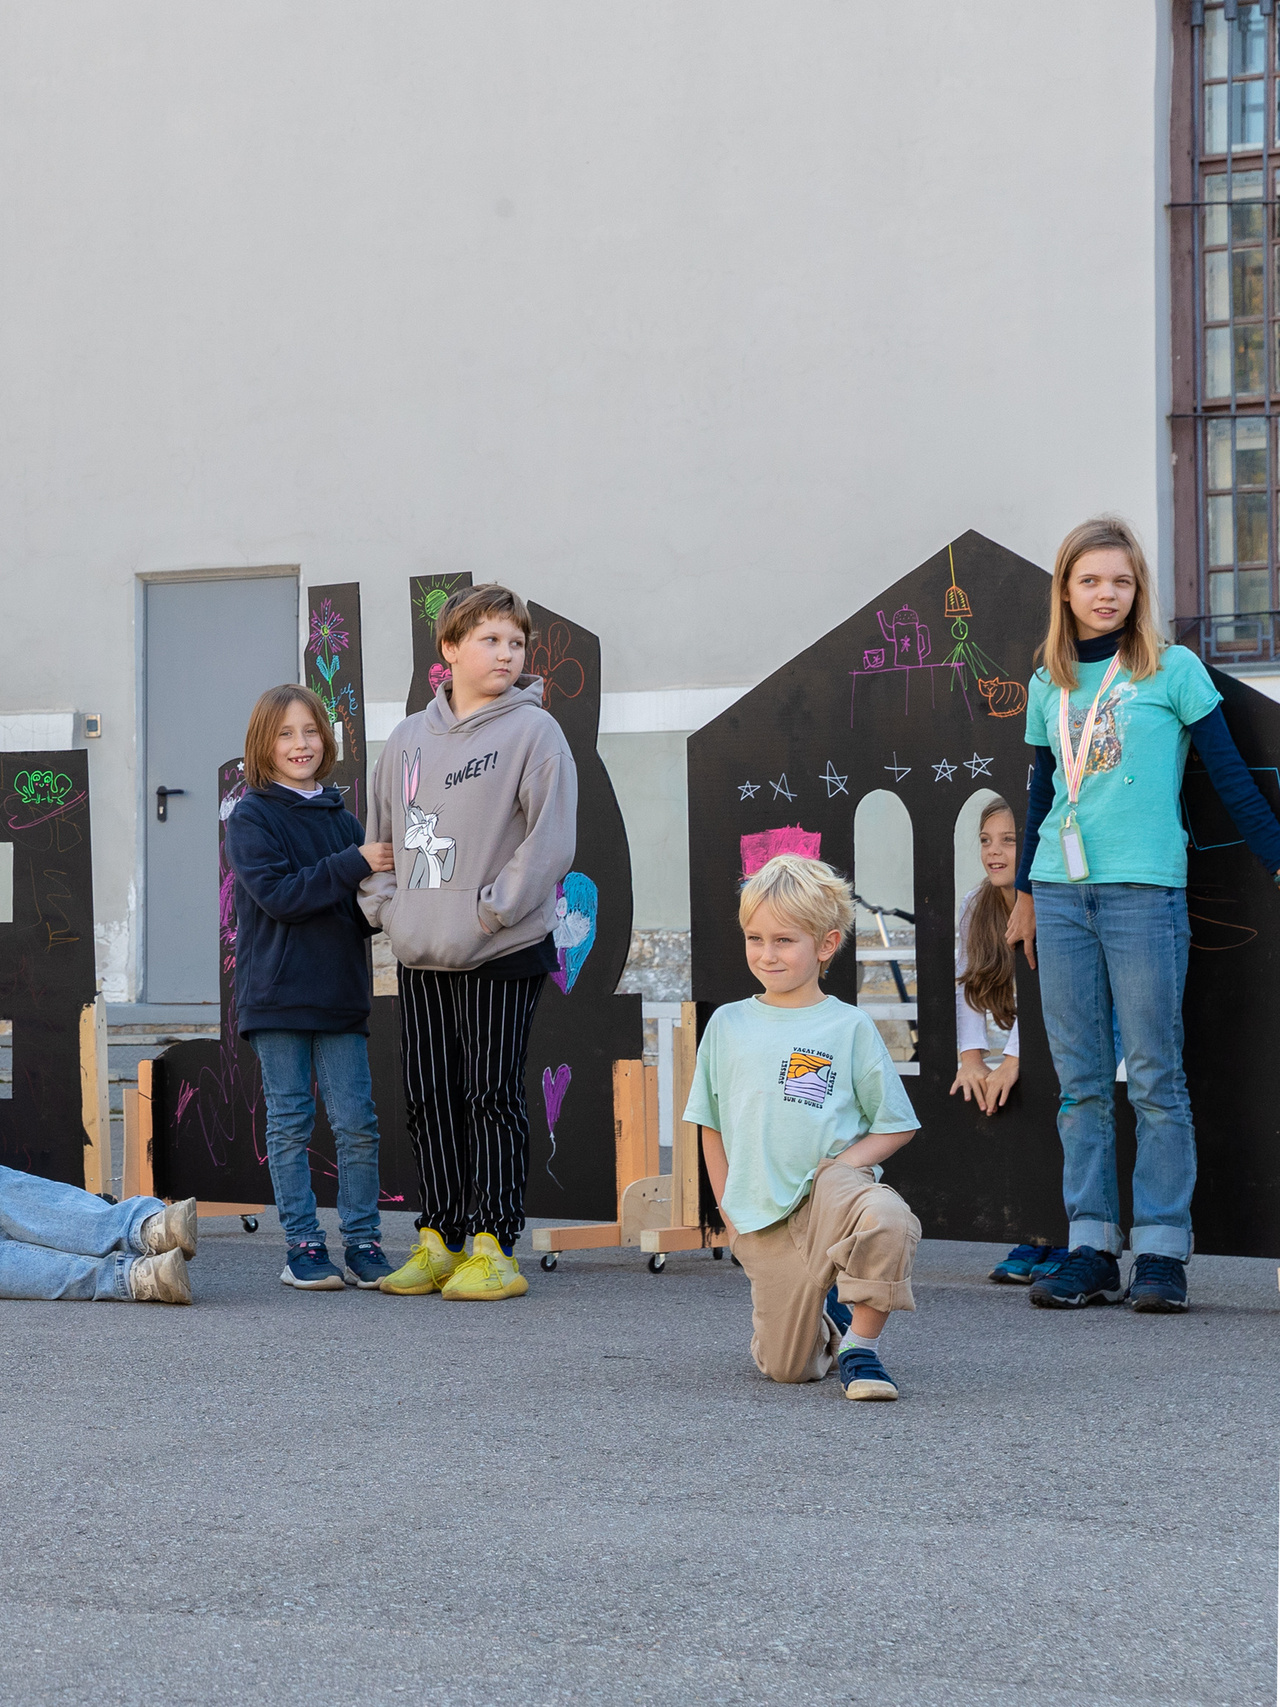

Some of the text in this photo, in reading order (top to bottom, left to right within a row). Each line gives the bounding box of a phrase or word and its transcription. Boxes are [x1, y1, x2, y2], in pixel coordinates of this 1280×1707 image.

[445, 751, 498, 789] SWEET!
[816, 1051, 833, 1060] MOOD
[778, 1060, 788, 1085] SUNSET
[826, 1071, 837, 1096] PLEASE
[804, 1101, 823, 1109] DUNES
